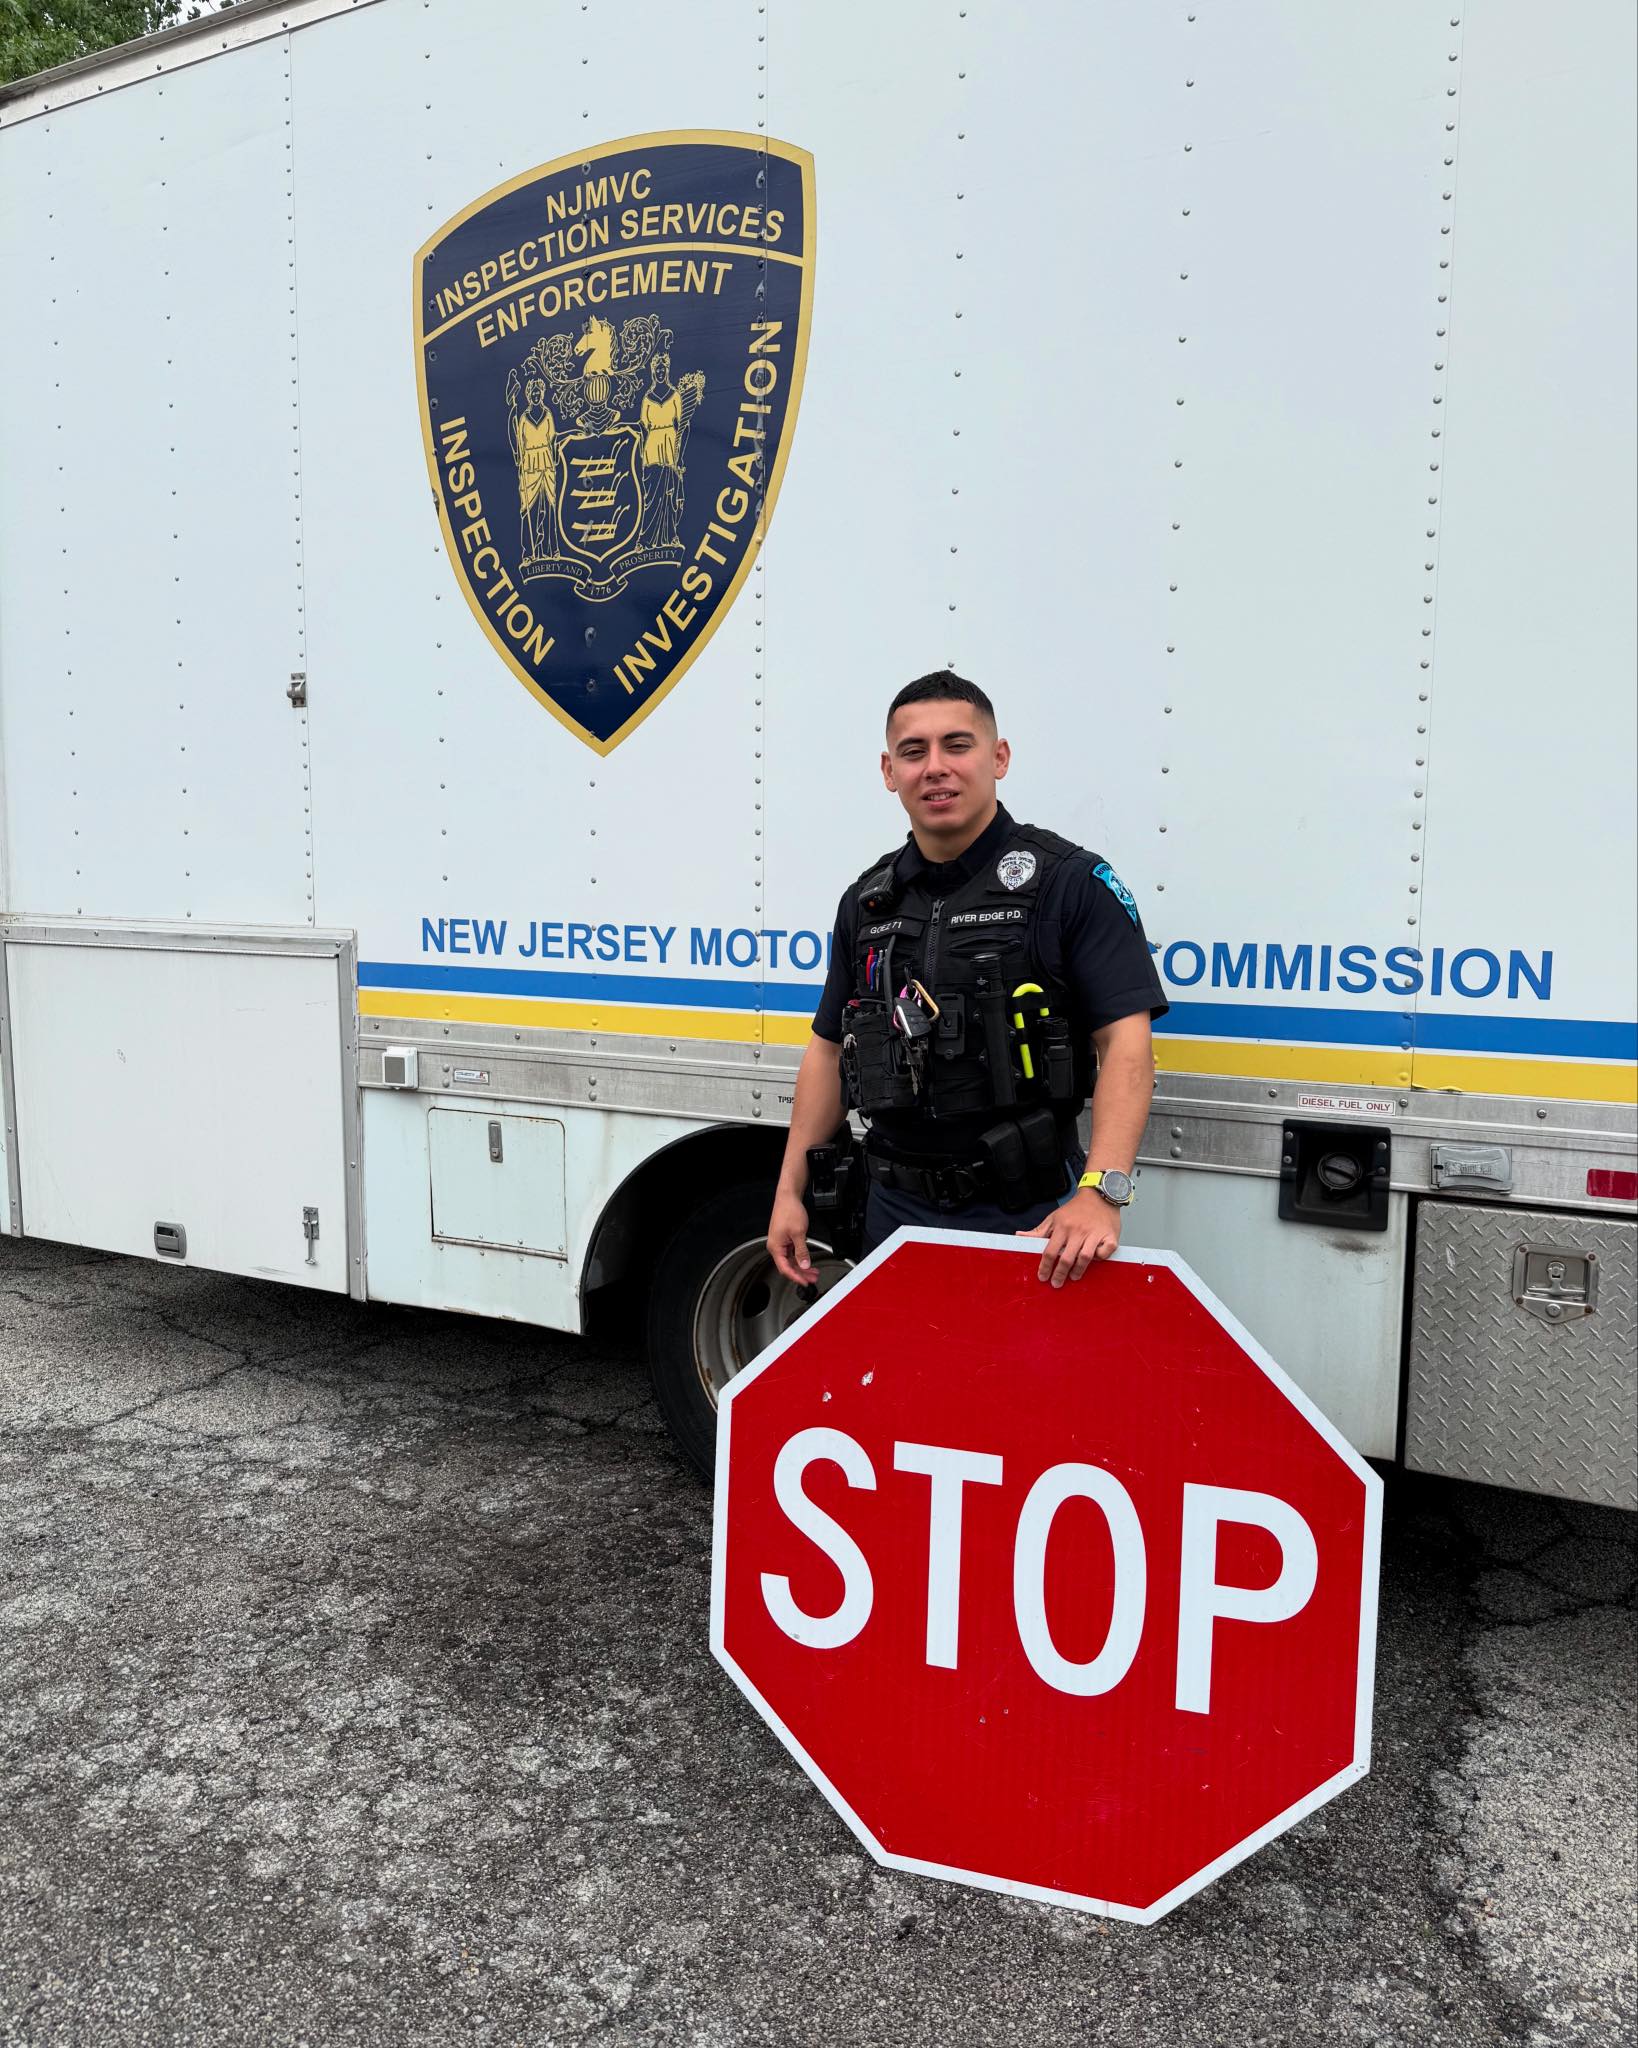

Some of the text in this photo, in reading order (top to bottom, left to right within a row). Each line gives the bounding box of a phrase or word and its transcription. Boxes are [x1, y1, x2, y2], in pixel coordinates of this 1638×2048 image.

[546, 168, 653, 224] NJMVC
[434, 203, 785, 319] INSPECTION SERVICES
[475, 259, 733, 349] ENFORCEMENT
[612, 320, 783, 695] INVESTIGATION
[439, 416, 556, 667] INSPECTION
[619, 549, 678, 571] PROSPERITY
[526, 563, 583, 577] LIBERTY AND
[590, 585, 612, 596] 1776
[422, 917, 832, 971] NEW JERSEY MOTO
[950, 910, 1023, 925] RIVER EDGE P.D.
[1146, 940, 1553, 1000] OMMISSION
[1302, 1097, 1391, 1112] DIESEL FUEL ONLY
[760, 1426, 1319, 1715] STOP
